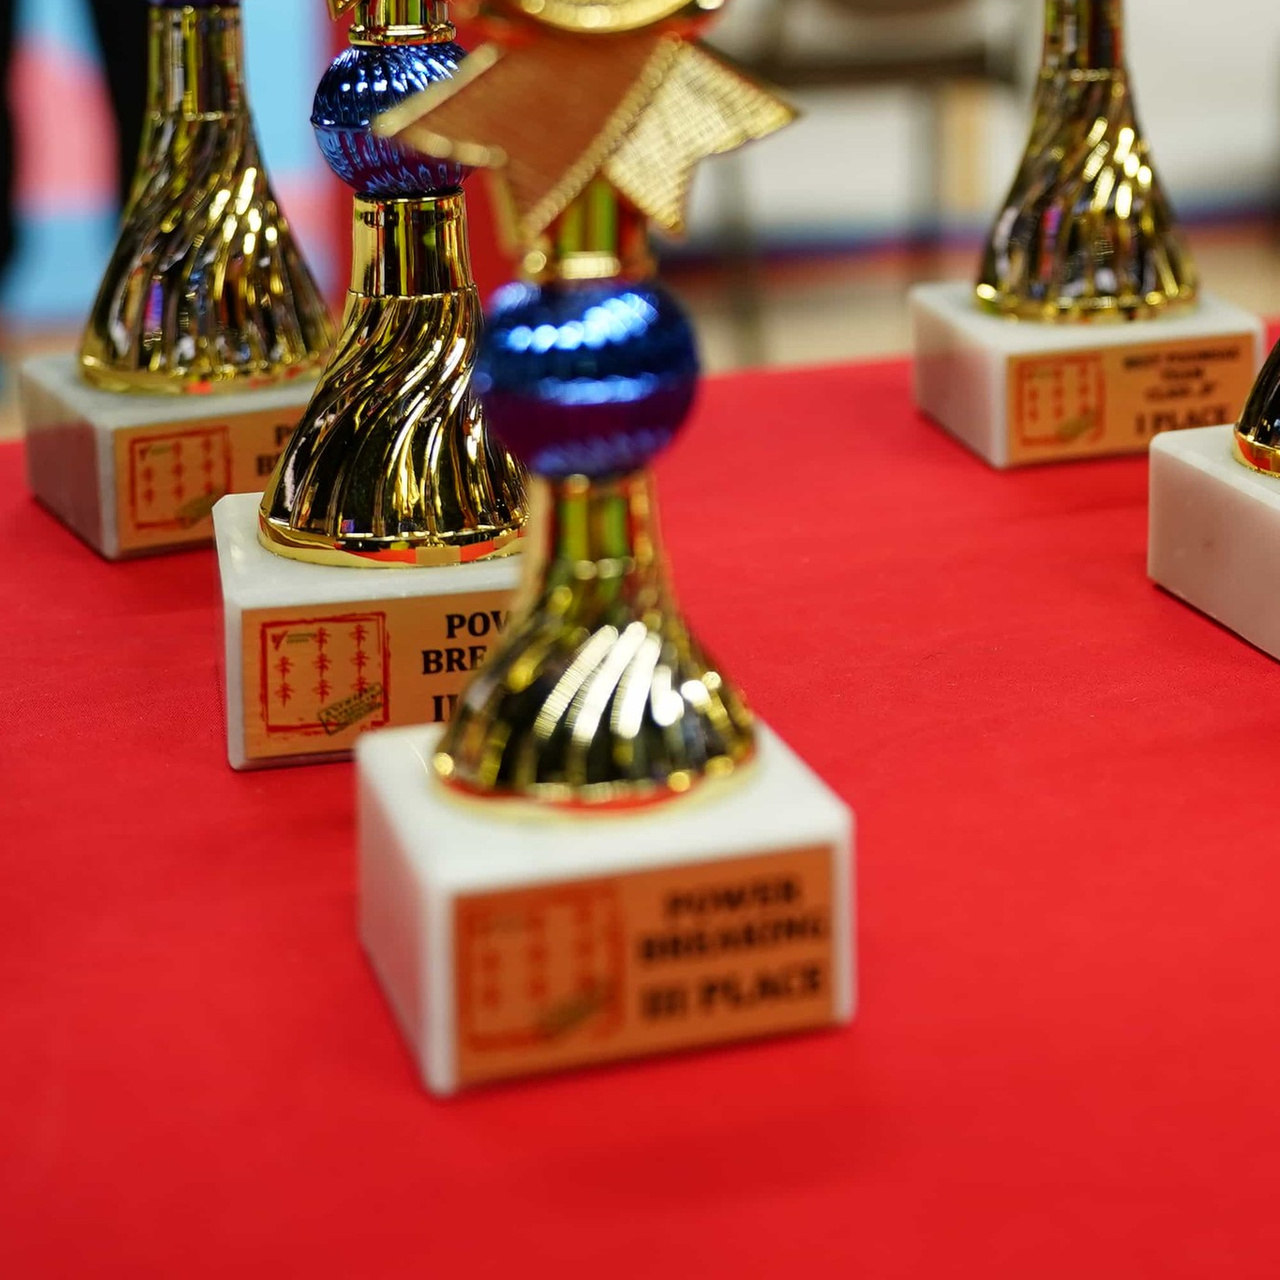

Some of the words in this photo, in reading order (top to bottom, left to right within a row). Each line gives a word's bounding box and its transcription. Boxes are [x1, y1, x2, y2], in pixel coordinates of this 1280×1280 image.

[665, 878, 799, 919] POWER
[637, 910, 829, 966] BREAKING
[639, 984, 689, 1024] III
[699, 962, 824, 1014] PLACE
